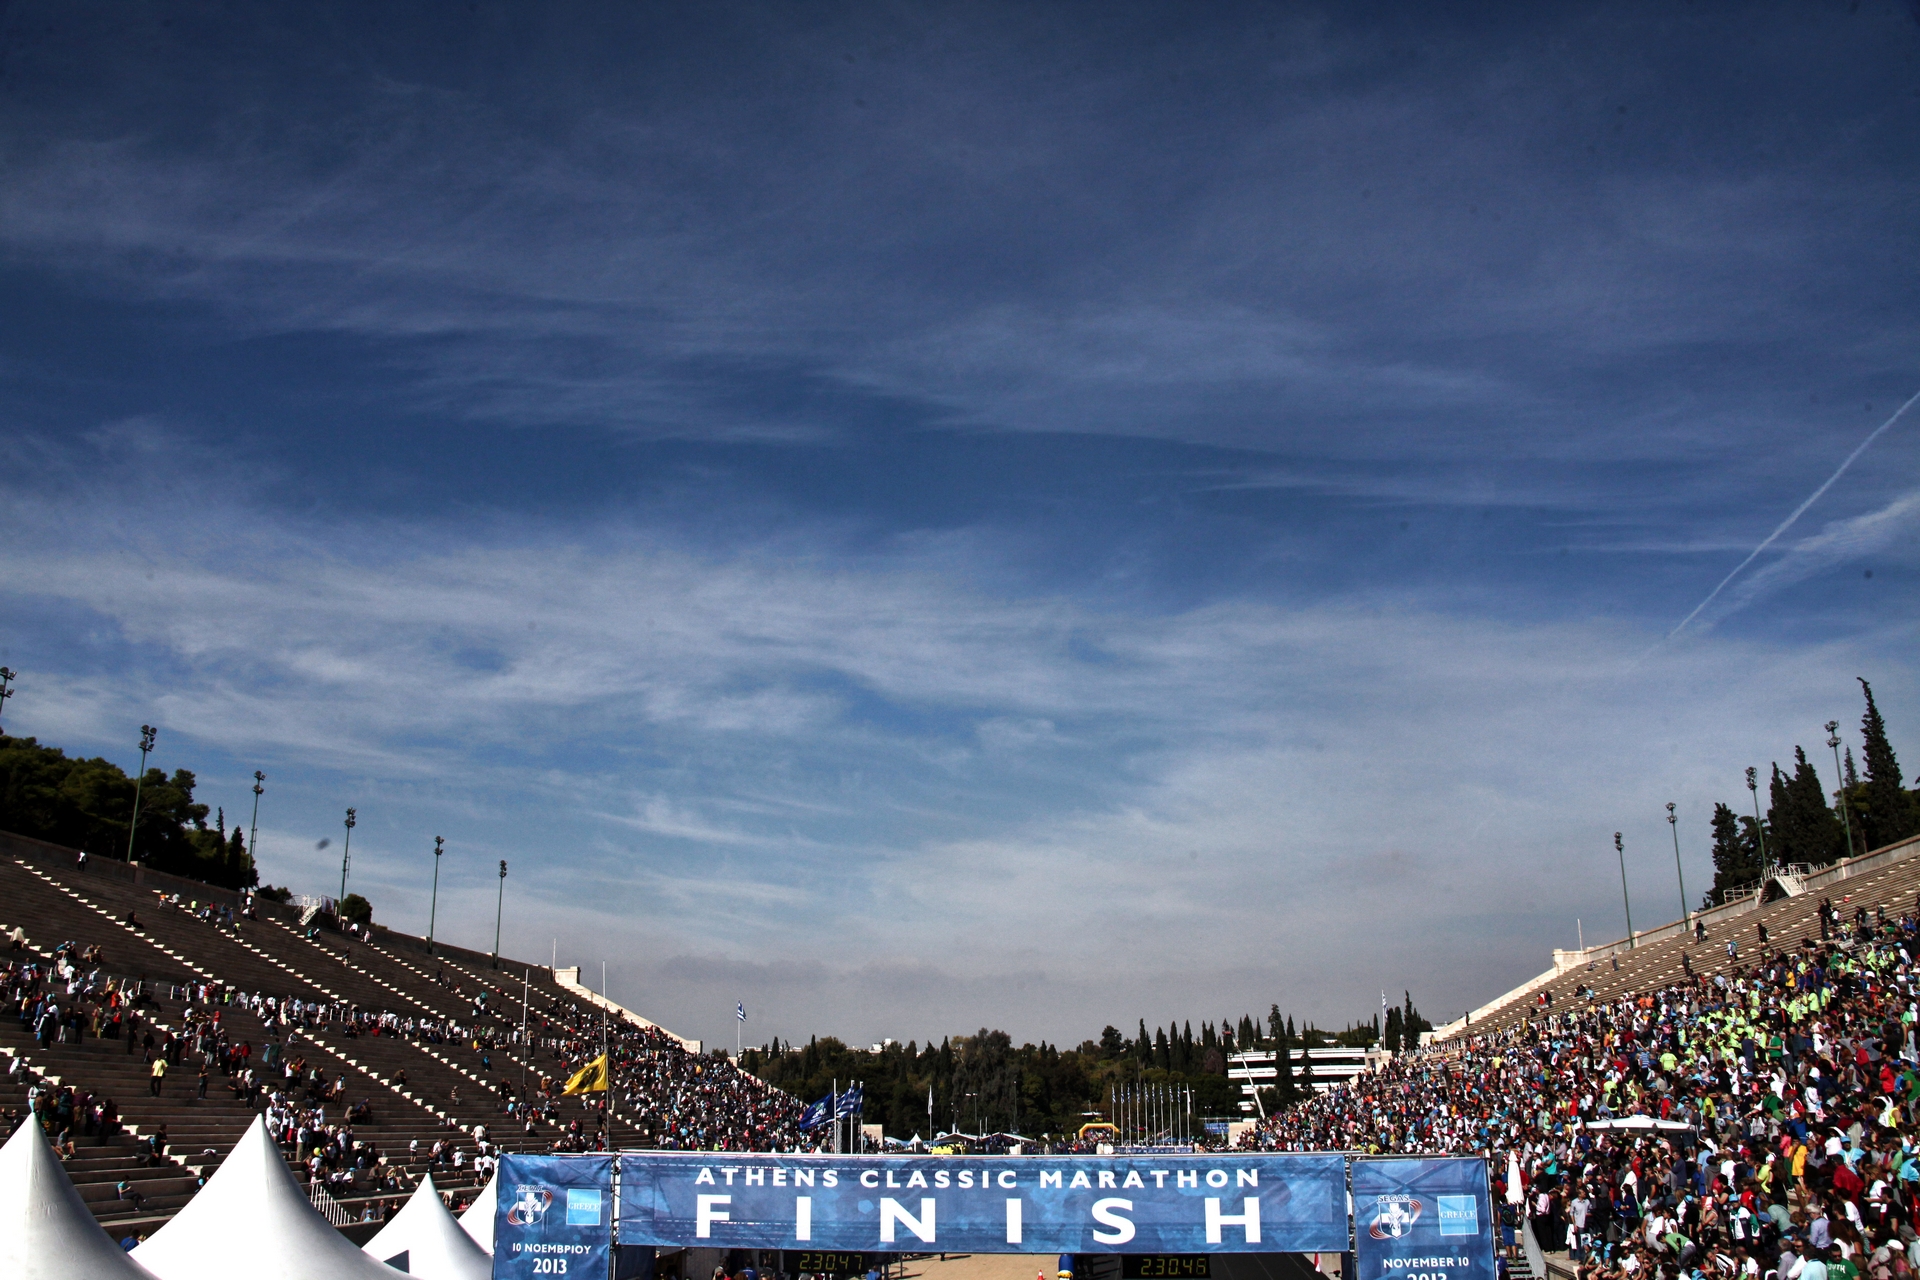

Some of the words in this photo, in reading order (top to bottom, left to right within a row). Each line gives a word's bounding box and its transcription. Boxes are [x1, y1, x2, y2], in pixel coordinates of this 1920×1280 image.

[694, 1167, 839, 1188] ATHENS
[859, 1169, 1018, 1189] CLASSIC
[1039, 1168, 1260, 1189] MARATHON
[1377, 1194, 1410, 1203] SEGAS
[568, 1202, 600, 1210] GREECE
[695, 1193, 1262, 1245] FINISH
[1440, 1210, 1476, 1219] GREECE
[512, 1242, 522, 1252] 10
[525, 1243, 592, 1254] ΝΟΕΜΒΡΙΟΥ
[532, 1258, 567, 1274] 2013
[1383, 1257, 1455, 1268] NOVEMBER
[1459, 1256, 1469, 1266] 10
